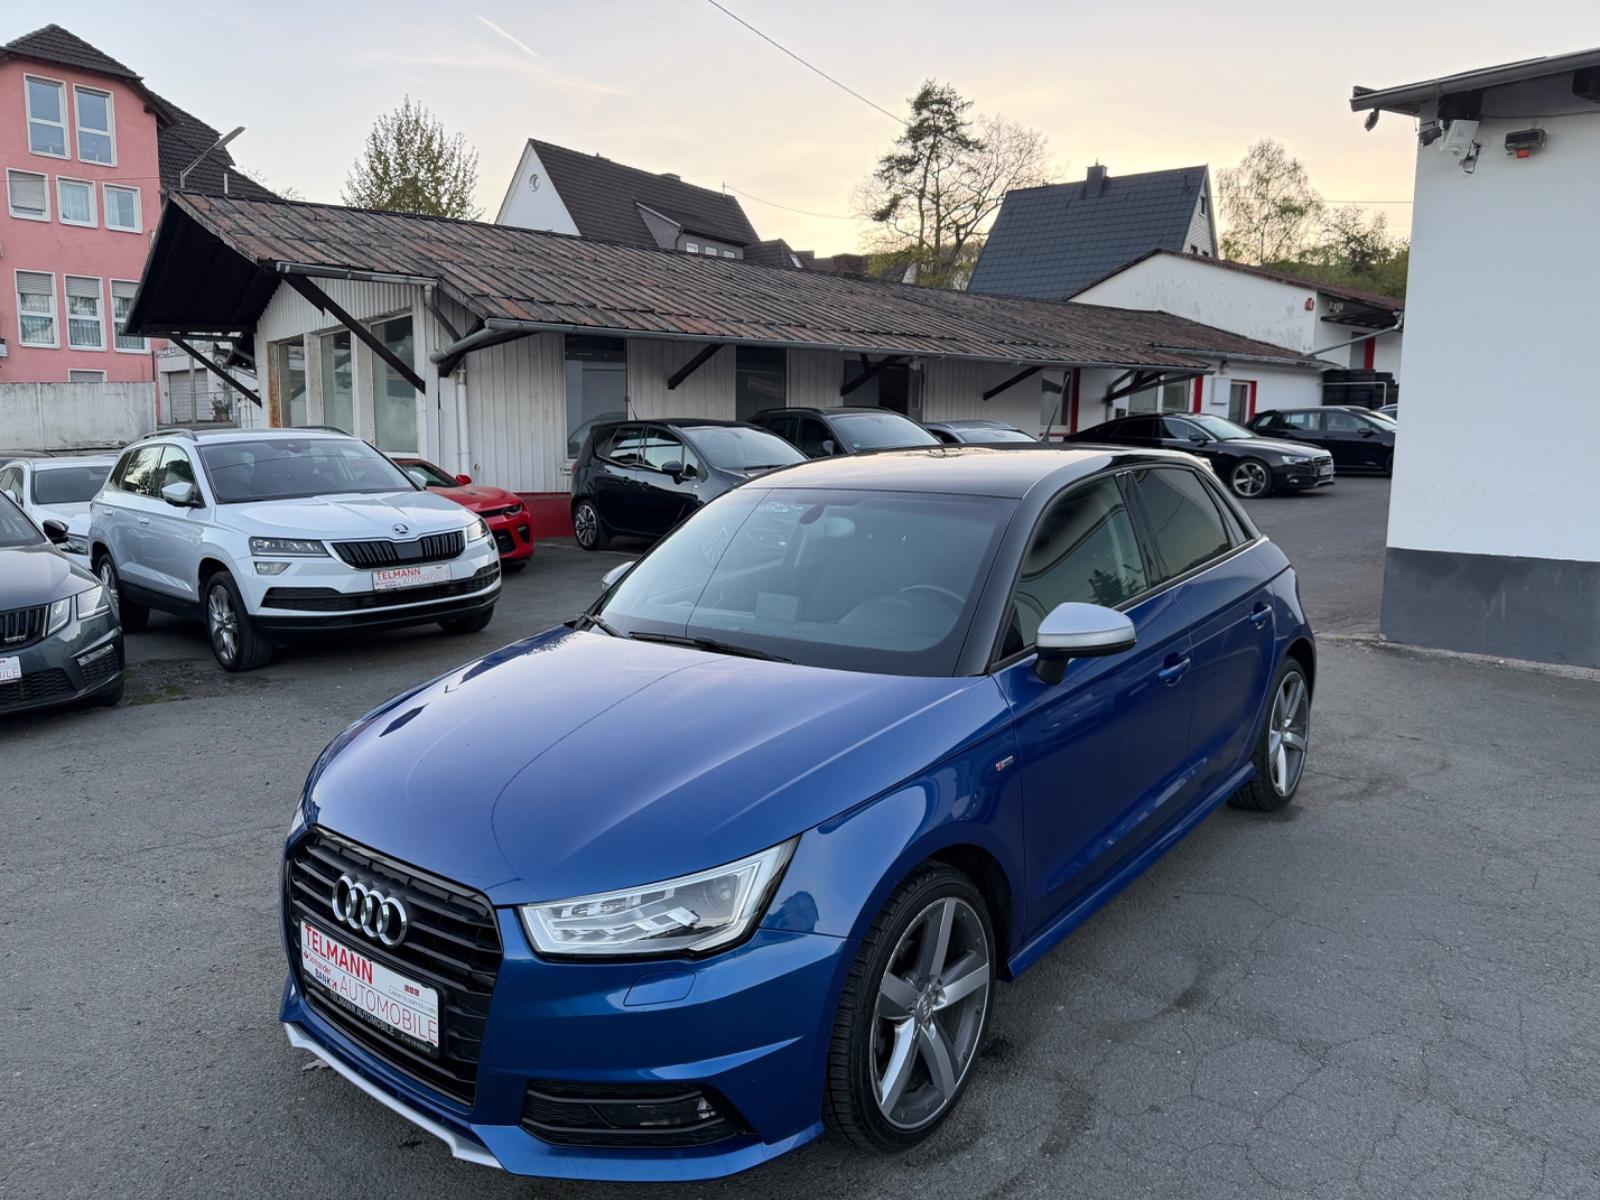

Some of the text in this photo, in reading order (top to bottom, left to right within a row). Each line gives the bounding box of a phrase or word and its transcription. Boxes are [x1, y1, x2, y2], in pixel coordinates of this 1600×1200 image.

[376, 567, 421, 580] TELMANN
[305, 924, 373, 984] TELMANN
[340, 975, 438, 1044] AUTOMOBILE
[355, 1008, 395, 1037] AUTOMOBILE
